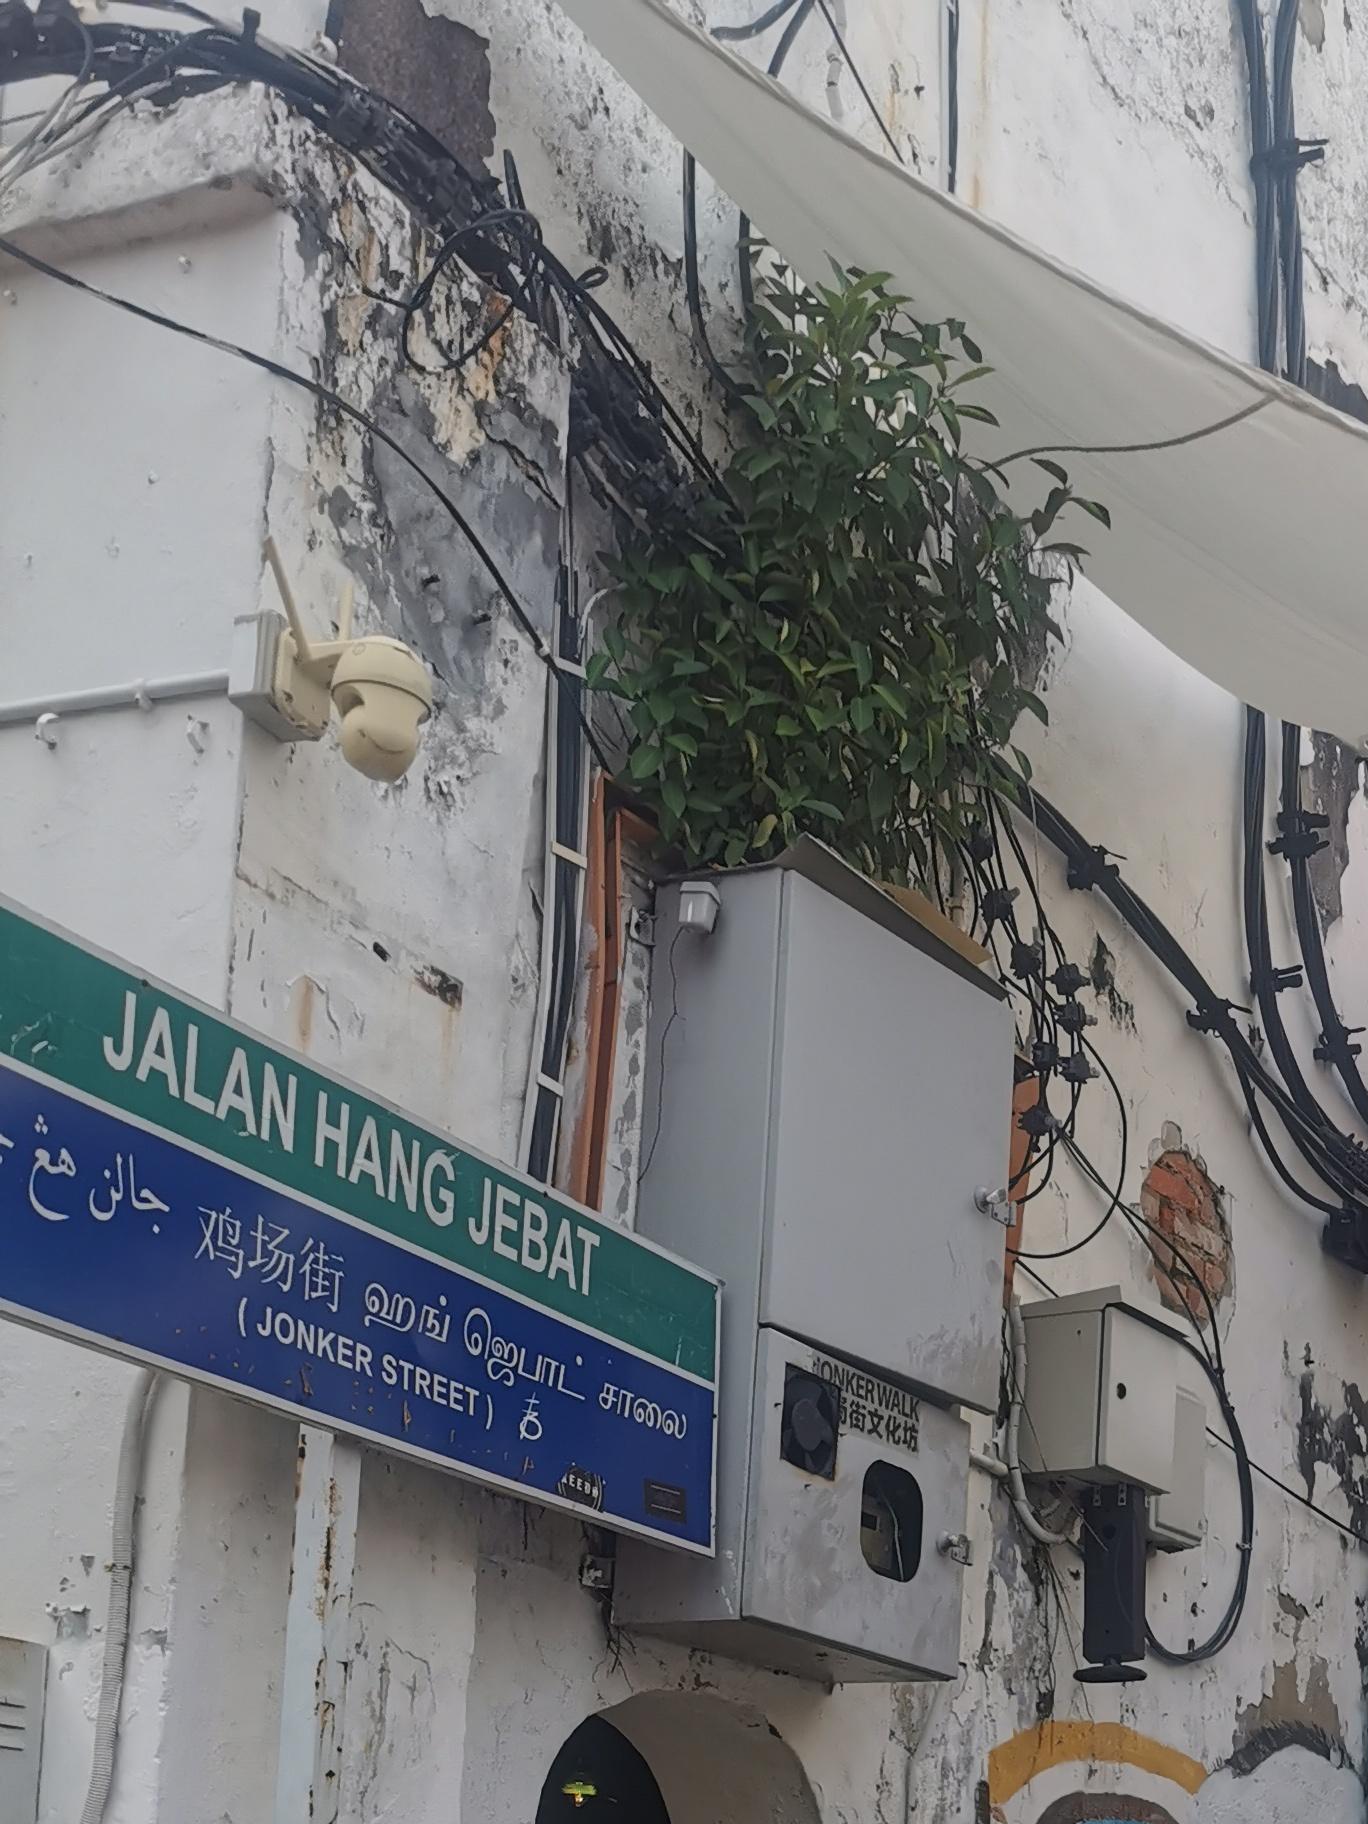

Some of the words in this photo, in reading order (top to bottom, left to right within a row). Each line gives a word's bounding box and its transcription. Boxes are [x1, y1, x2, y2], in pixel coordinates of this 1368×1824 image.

[103, 990, 298, 1154] JALAN
[313, 1090, 457, 1228] HANG
[468, 1178, 601, 1296] JEBAT
[193, 1204, 345, 1313] 鸡场街
